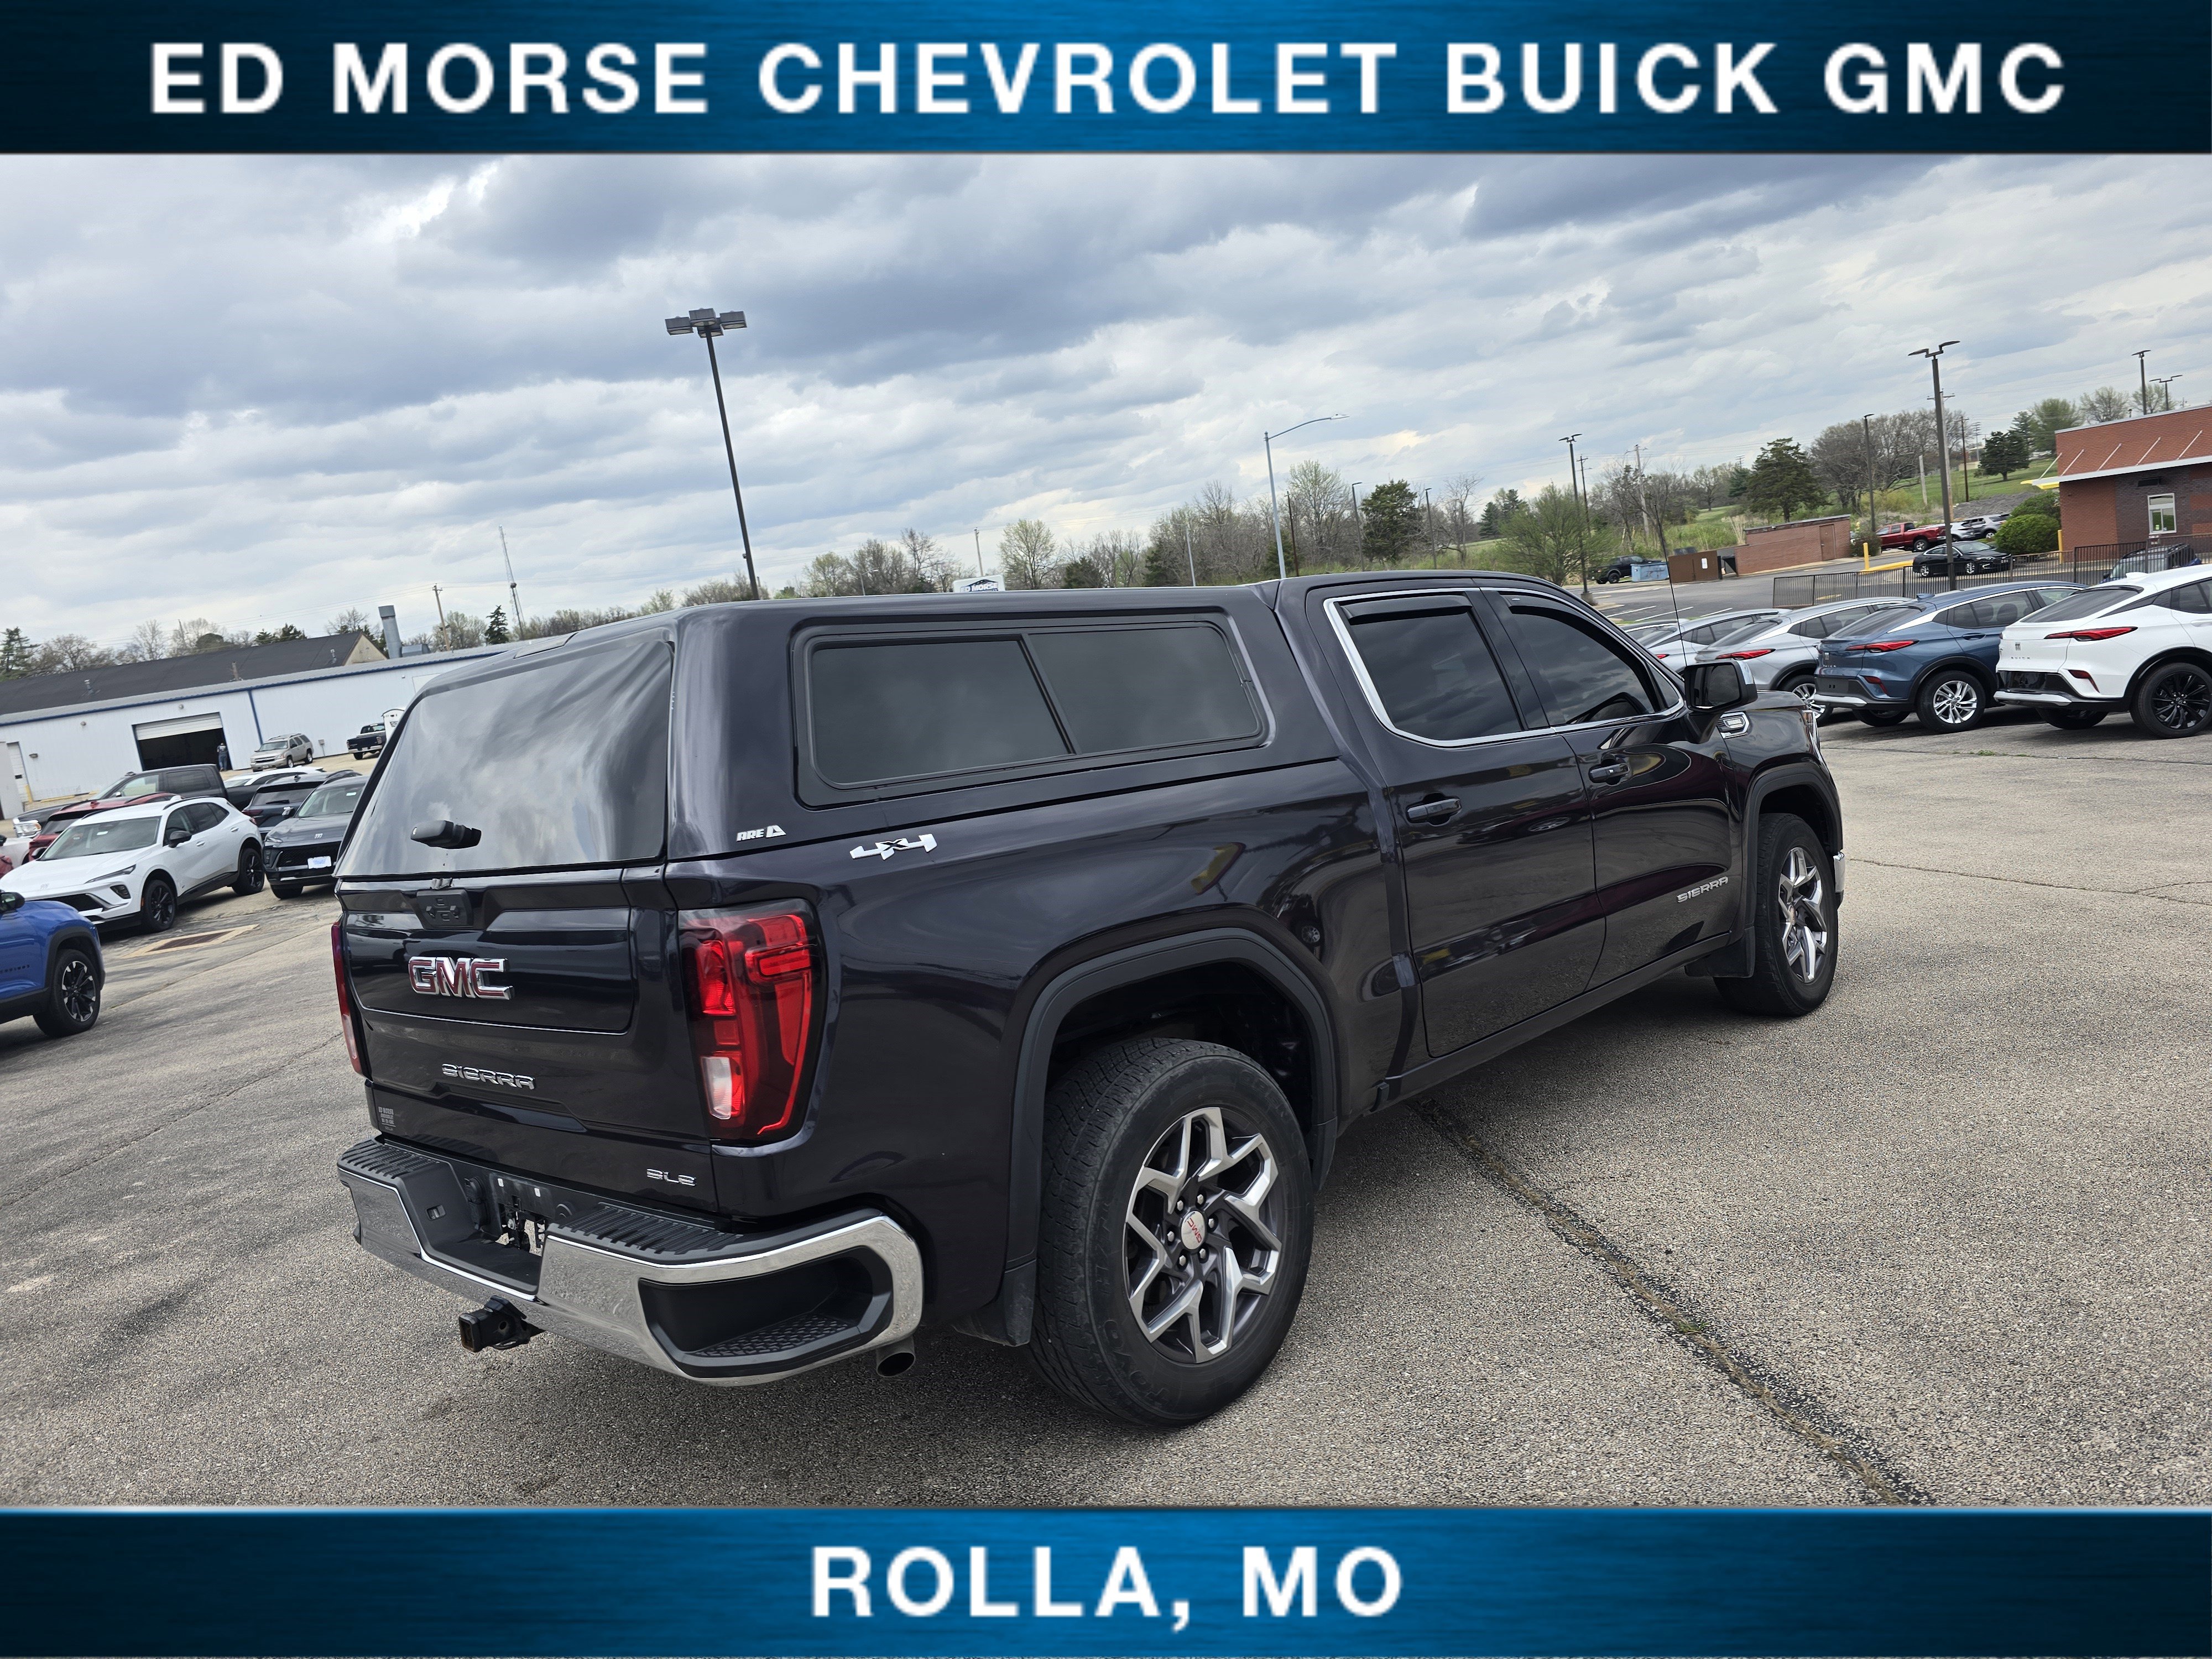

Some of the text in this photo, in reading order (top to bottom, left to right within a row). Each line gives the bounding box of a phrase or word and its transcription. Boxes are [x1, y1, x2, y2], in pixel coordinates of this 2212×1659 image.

[971, 582, 998, 592] MORSE
[737, 829, 764, 841] ARE
[1677, 876, 1729, 903] SIERRA
[408, 956, 514, 1000] GMC
[442, 1063, 535, 1090] SIERRA
[646, 1168, 696, 1186] SLE
[1187, 1217, 1202, 1243] GMC
